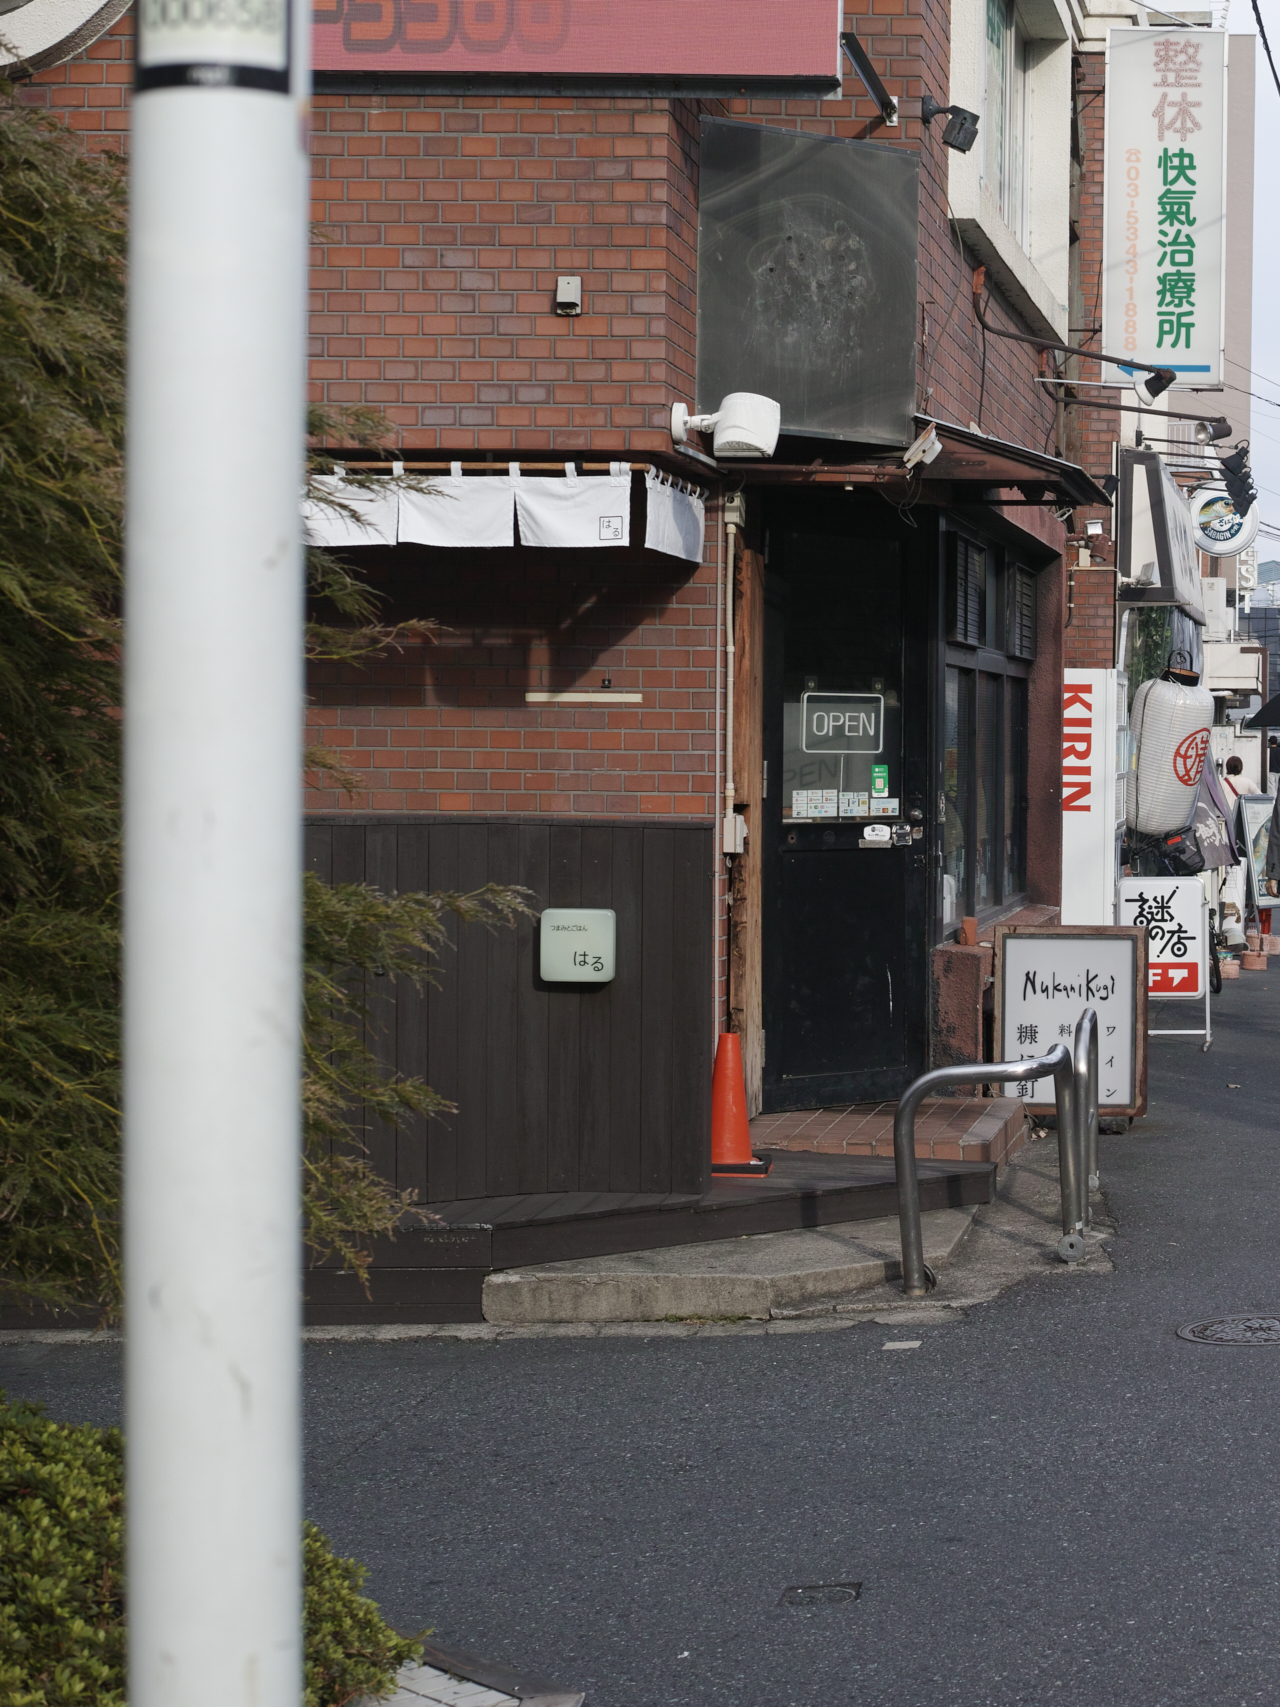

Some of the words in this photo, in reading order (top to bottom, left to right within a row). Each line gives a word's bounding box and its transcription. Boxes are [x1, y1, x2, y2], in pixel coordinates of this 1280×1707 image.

[1151, 38, 1204, 143] 整体
[1156, 147, 1198, 350] 快氣治療所
[602, 519, 620, 537] はる
[1204, 527, 1232, 541] SABAGIN
[813, 712, 875, 736] OPEN
[1062, 683, 1093, 813] KIRIN
[550, 924, 588, 932] つまみとごはん
[573, 951, 604, 972] はる
[1105, 1026, 1117, 1098] ワイン
